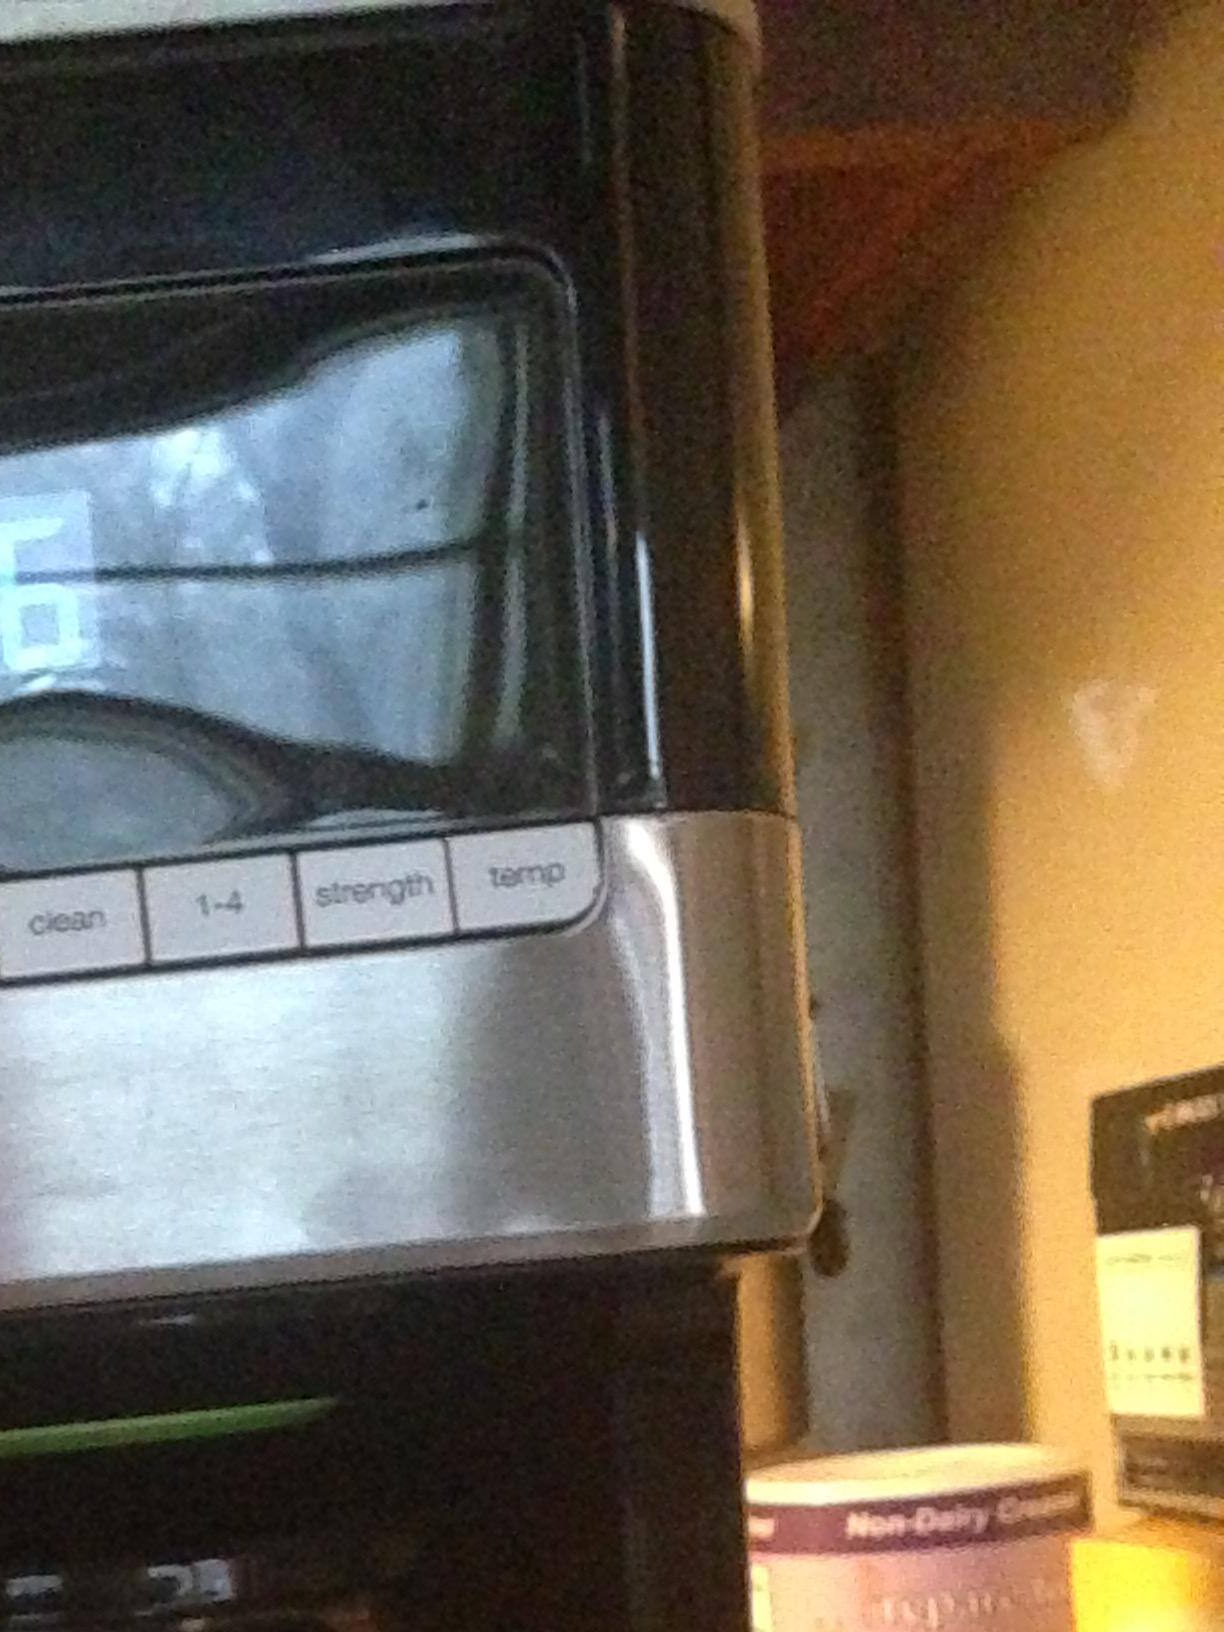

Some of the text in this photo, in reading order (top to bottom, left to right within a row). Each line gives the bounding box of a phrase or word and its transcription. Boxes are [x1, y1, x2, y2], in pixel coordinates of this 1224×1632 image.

[314, 868, 437, 907] strength
[487, 857, 566, 888] temp
[194, 889, 244, 917] 1-4
[27, 906, 107, 938] clean
